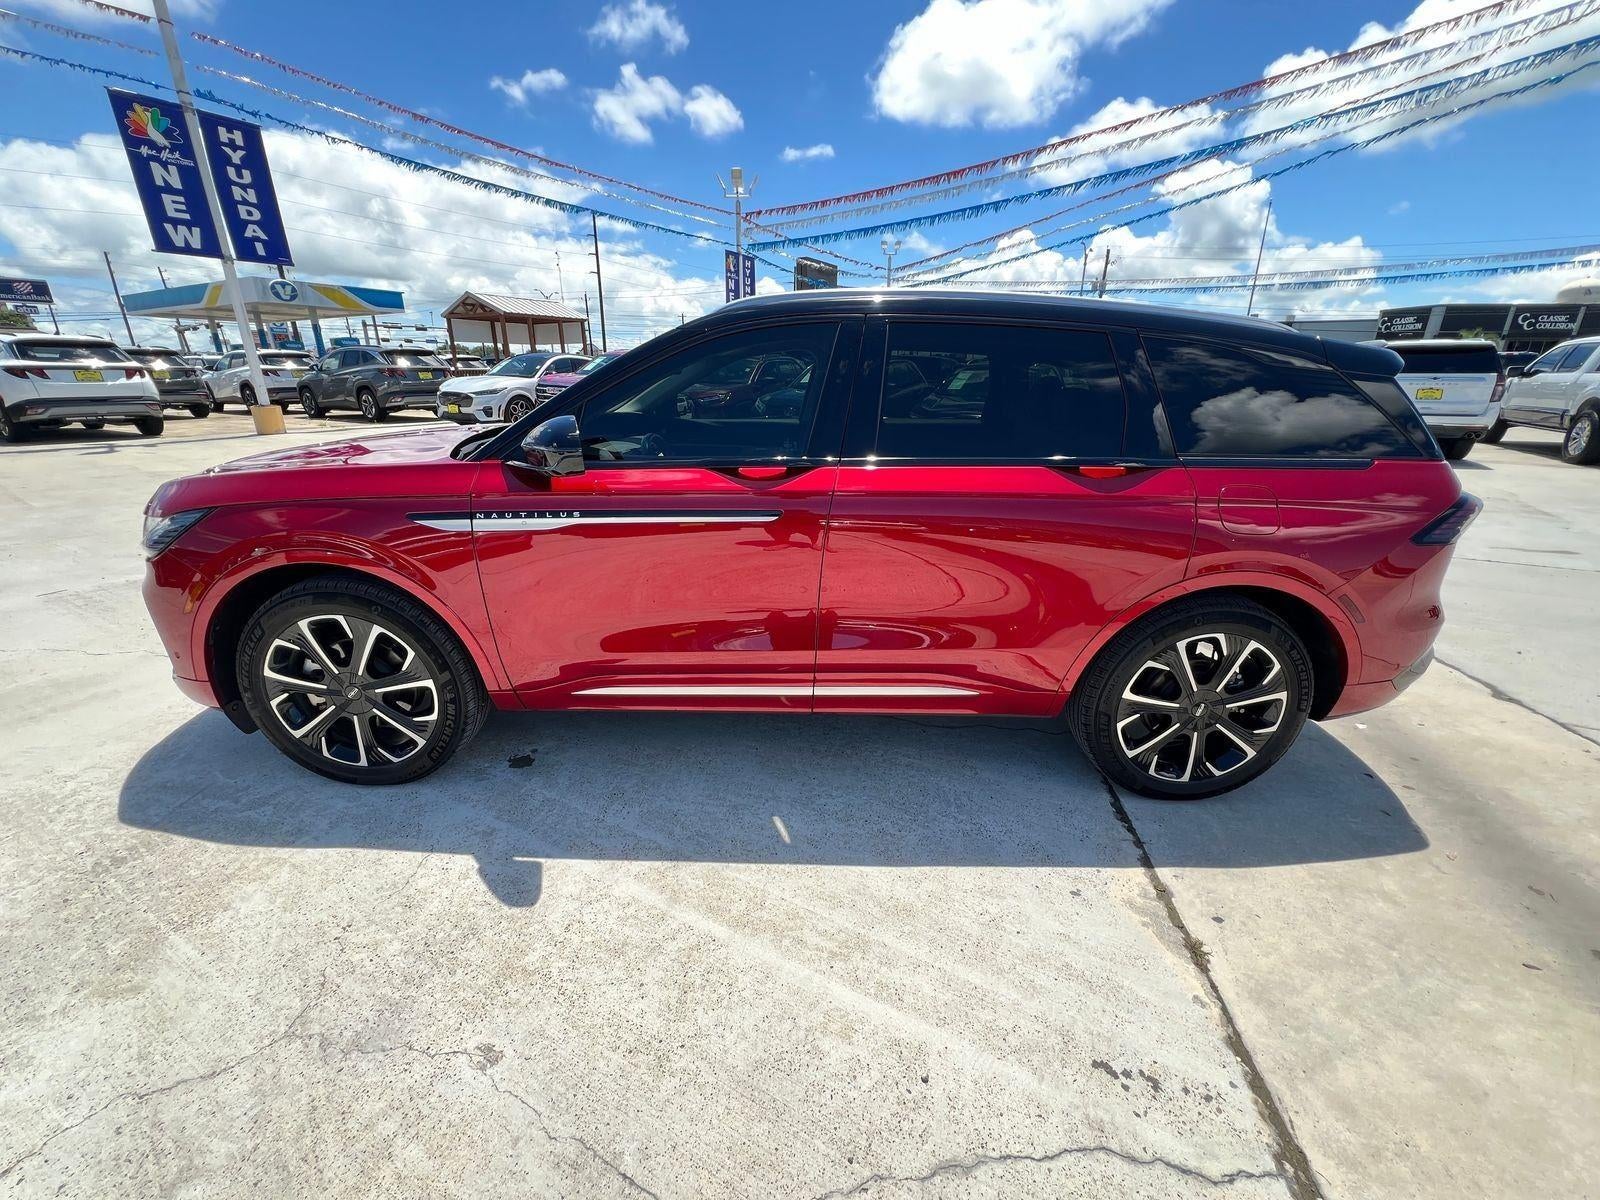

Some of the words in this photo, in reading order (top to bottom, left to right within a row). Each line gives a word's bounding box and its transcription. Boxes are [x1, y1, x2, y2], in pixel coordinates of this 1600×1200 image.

[217, 126, 269, 256] HYUNDAI
[150, 161, 202, 249] NEW
[0, 293, 51, 301] mericanBank
[17, 305, 38, 314] atm
[1392, 316, 1418, 325] CLASSIC
[1390, 323, 1423, 332] COLLISION
[1535, 322, 1577, 330] COLLISION
[476, 511, 581, 520] NAUTILUS
[1290, 649, 1309, 712] MICHELIN
[430, 703, 457, 761] MICHELIN
